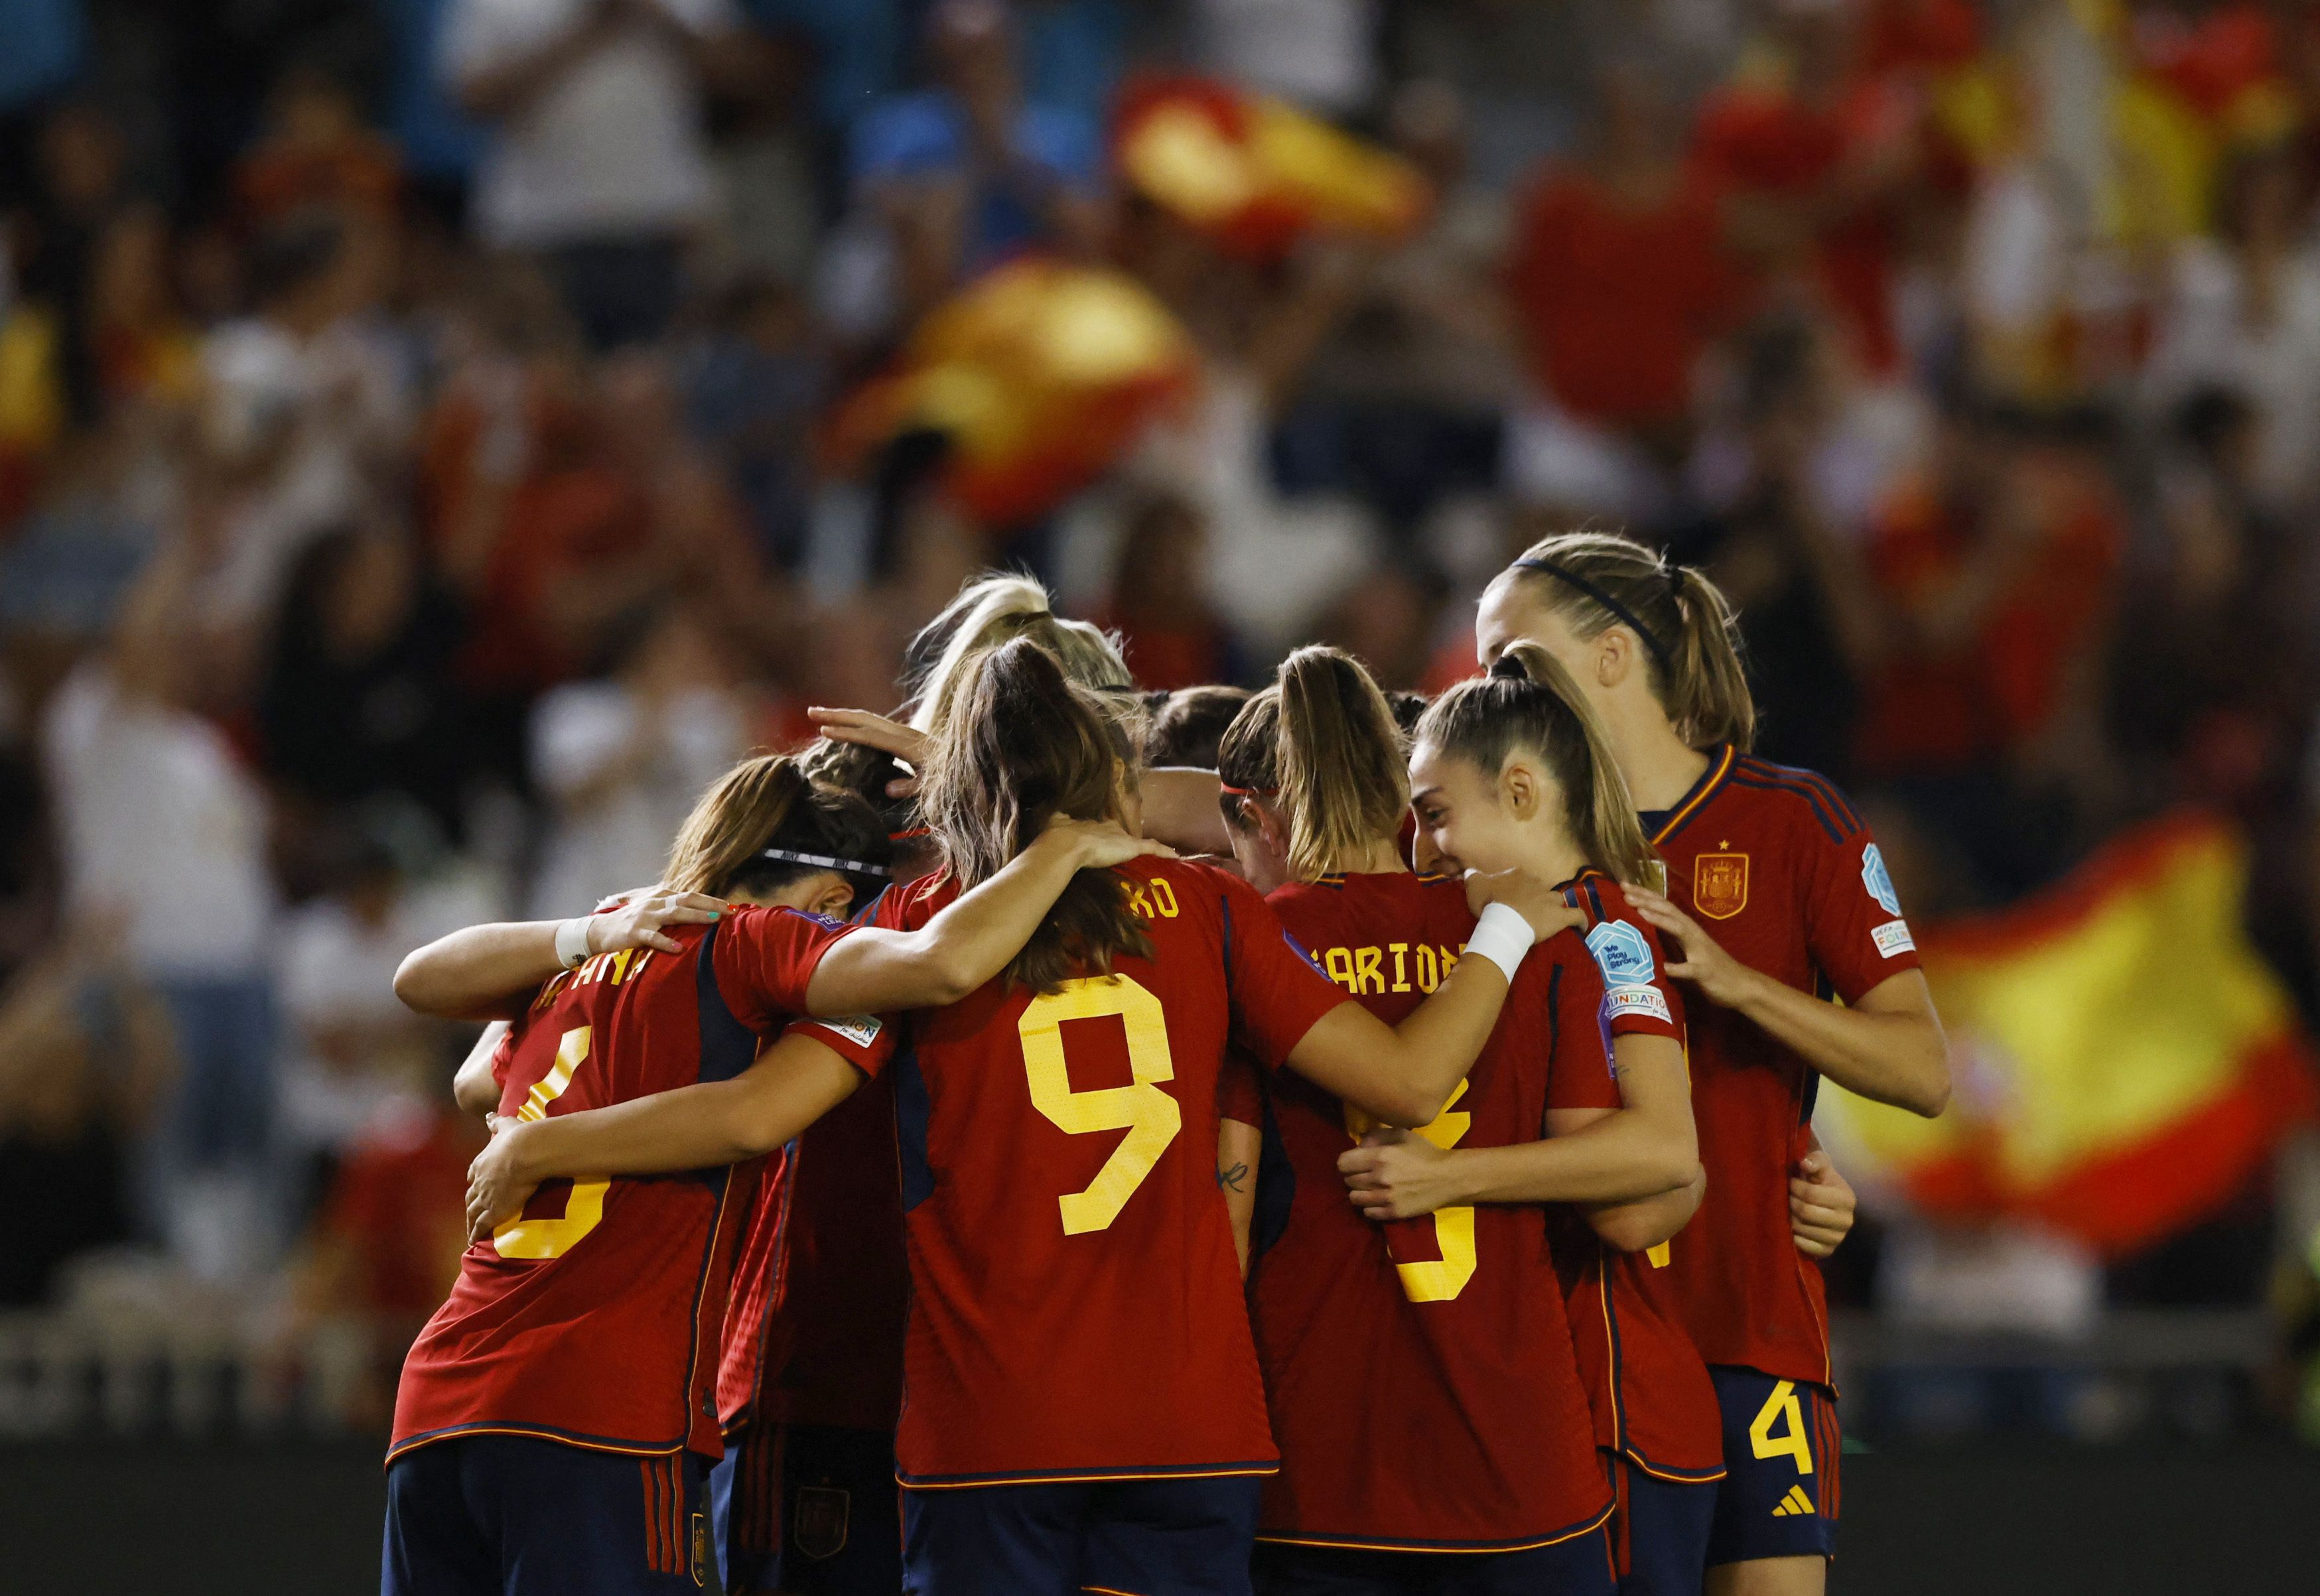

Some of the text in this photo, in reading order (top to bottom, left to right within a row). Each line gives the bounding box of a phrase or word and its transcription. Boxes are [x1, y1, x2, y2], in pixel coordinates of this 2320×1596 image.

[1310, 942, 1467, 995] ARION
[1610, 994, 1665, 1008] UNDATIO
[1018, 972, 1182, 1236] 9
[1749, 1379, 1814, 1475] 4
